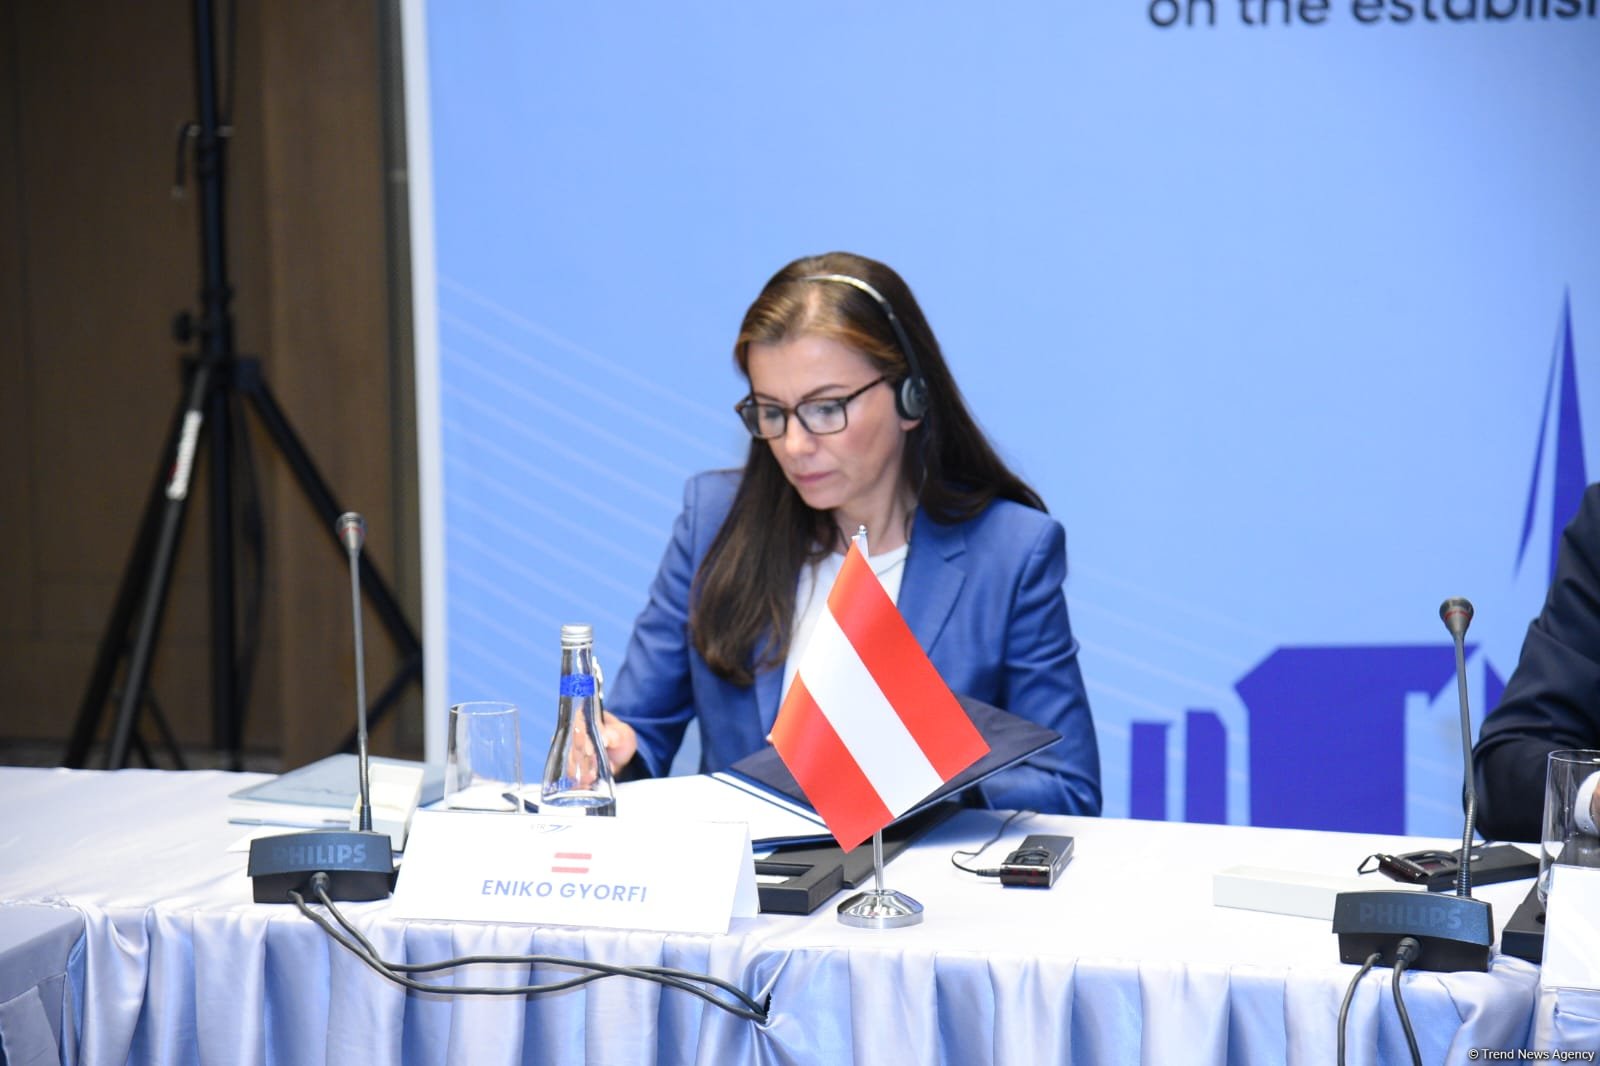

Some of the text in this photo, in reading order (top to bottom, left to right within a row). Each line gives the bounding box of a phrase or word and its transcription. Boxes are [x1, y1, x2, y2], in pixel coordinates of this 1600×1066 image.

[1149, 0, 1216, 27] on
[1240, 0, 1329, 25] the
[271, 843, 368, 866] PHILIPS
[482, 879, 647, 902] ENIKO GYORFI
[1359, 902, 1462, 930] PHILIPS
